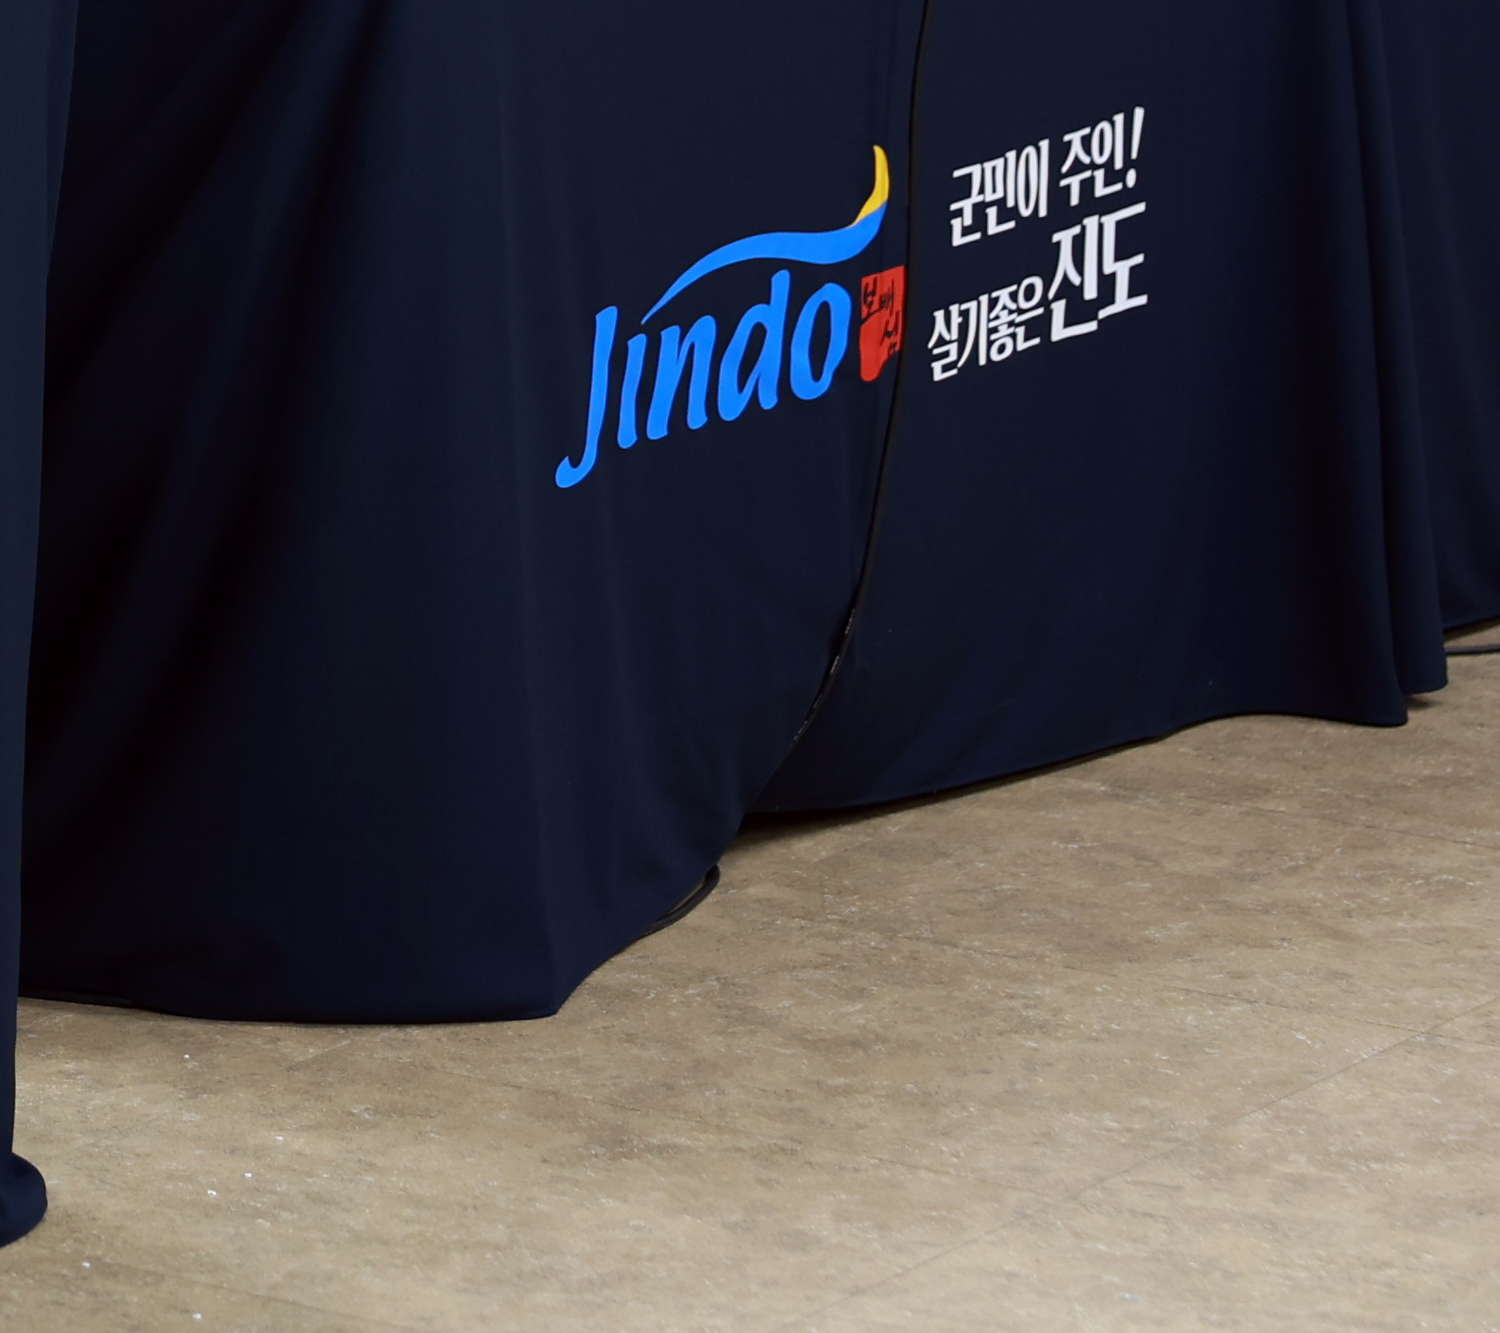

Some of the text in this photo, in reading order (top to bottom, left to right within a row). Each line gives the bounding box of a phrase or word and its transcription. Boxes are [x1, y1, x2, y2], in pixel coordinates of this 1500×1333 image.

[949, 106, 1146, 247] 군민이 주인!
[555, 268, 852, 489] Jindo
[927, 201, 1148, 383] 살기좋은 진도
